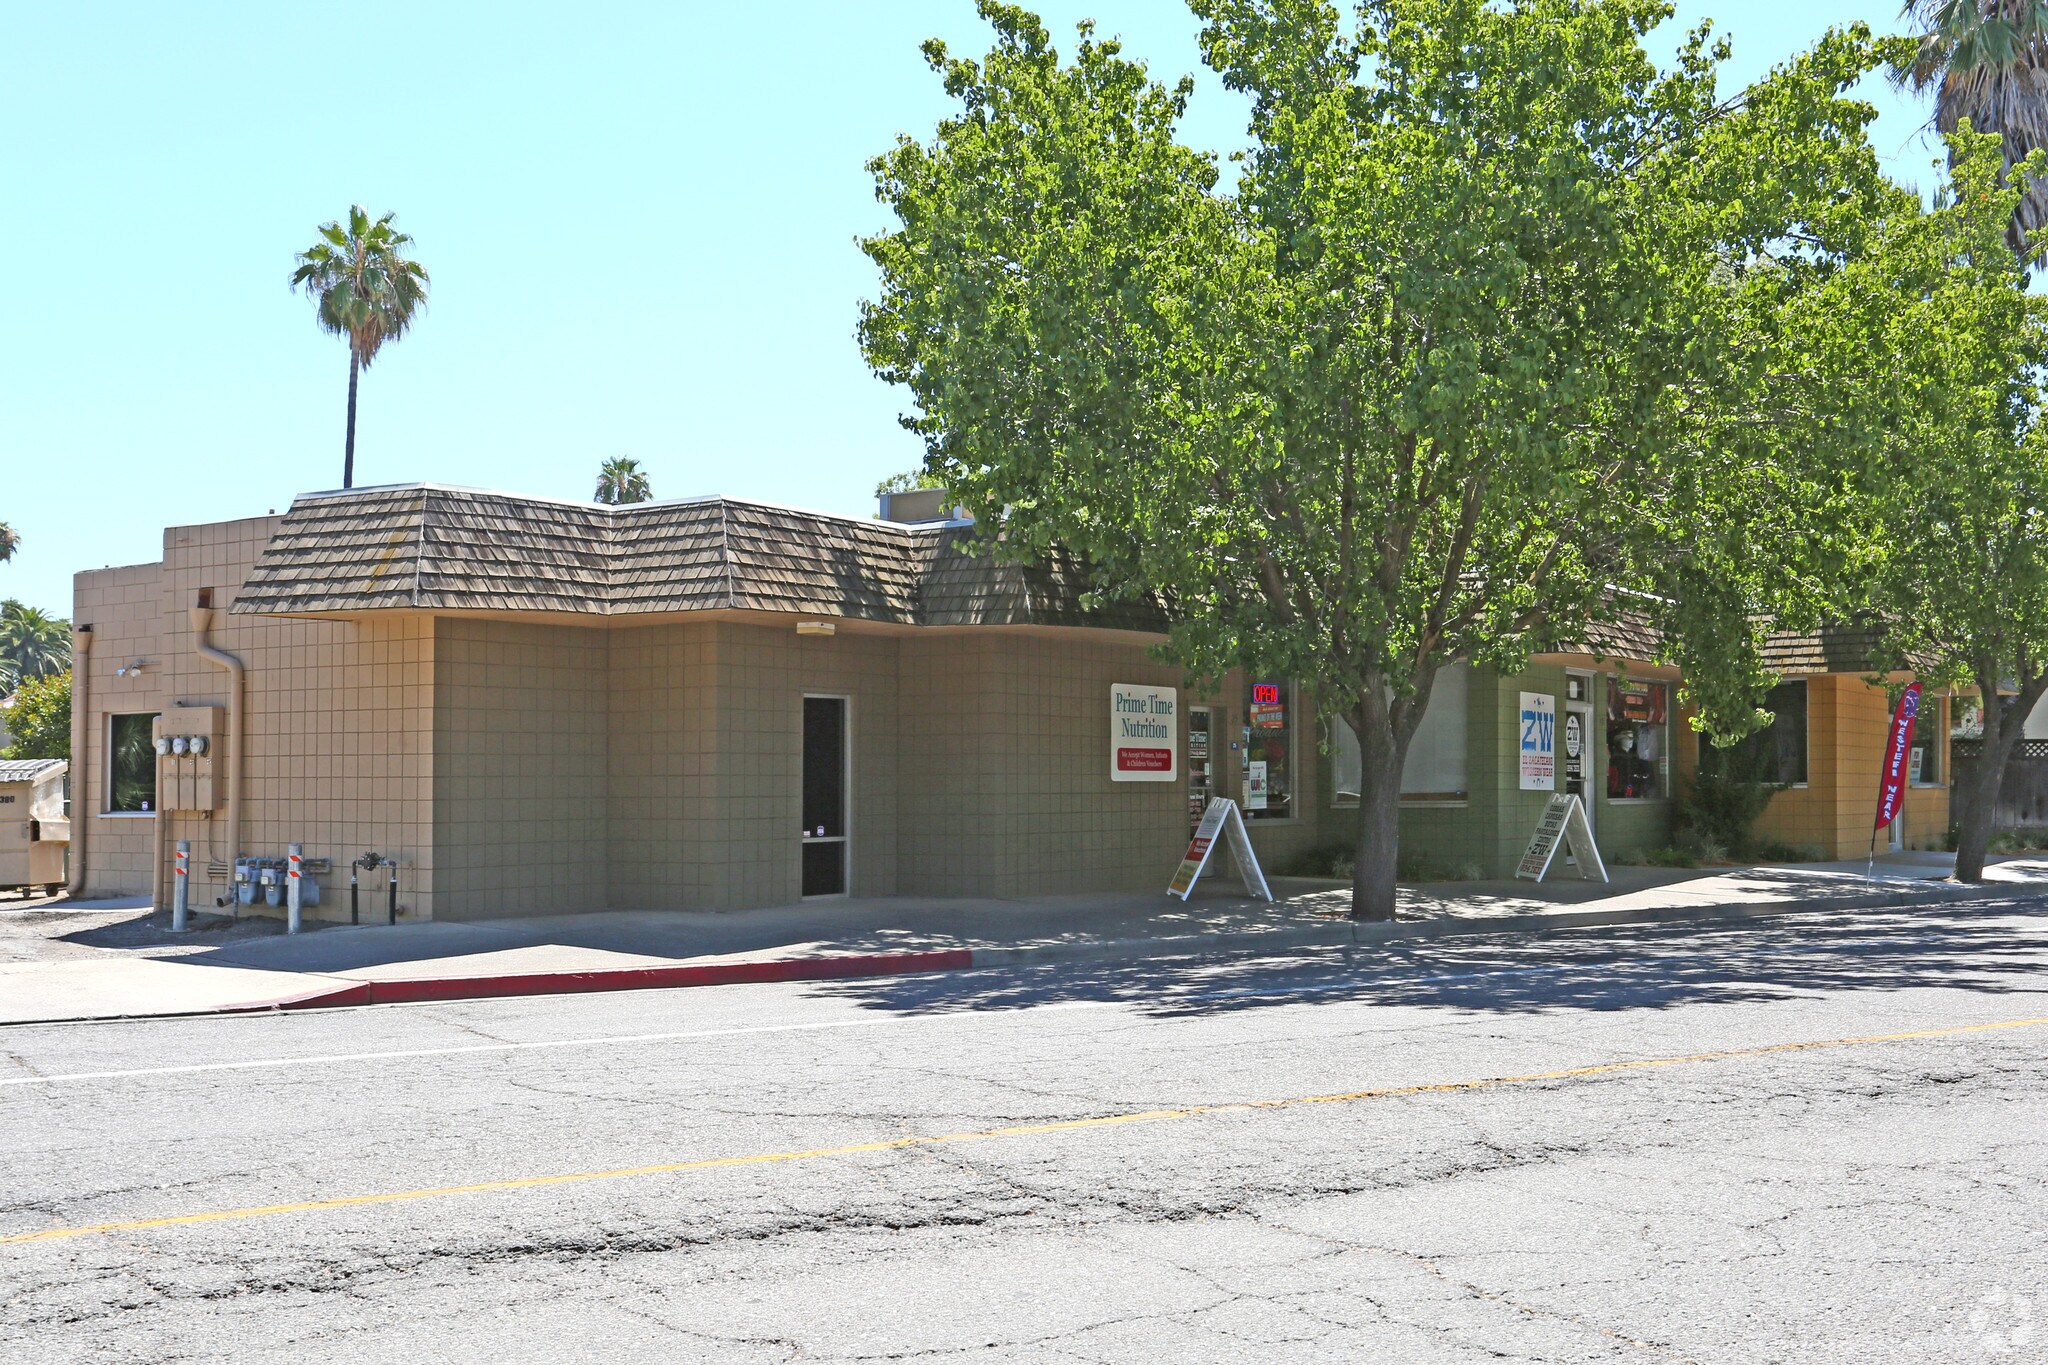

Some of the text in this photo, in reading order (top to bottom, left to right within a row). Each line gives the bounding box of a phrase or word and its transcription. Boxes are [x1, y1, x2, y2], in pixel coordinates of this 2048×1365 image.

[1116, 692, 1173, 715] Prime Time
[1255, 685, 1277, 702] OPEN
[1121, 717, 1168, 738] Nutrition
[1521, 710, 1554, 752] ZW
[1884, 784, 1898, 820] WEAR
[1531, 844, 1549, 855] ZW
